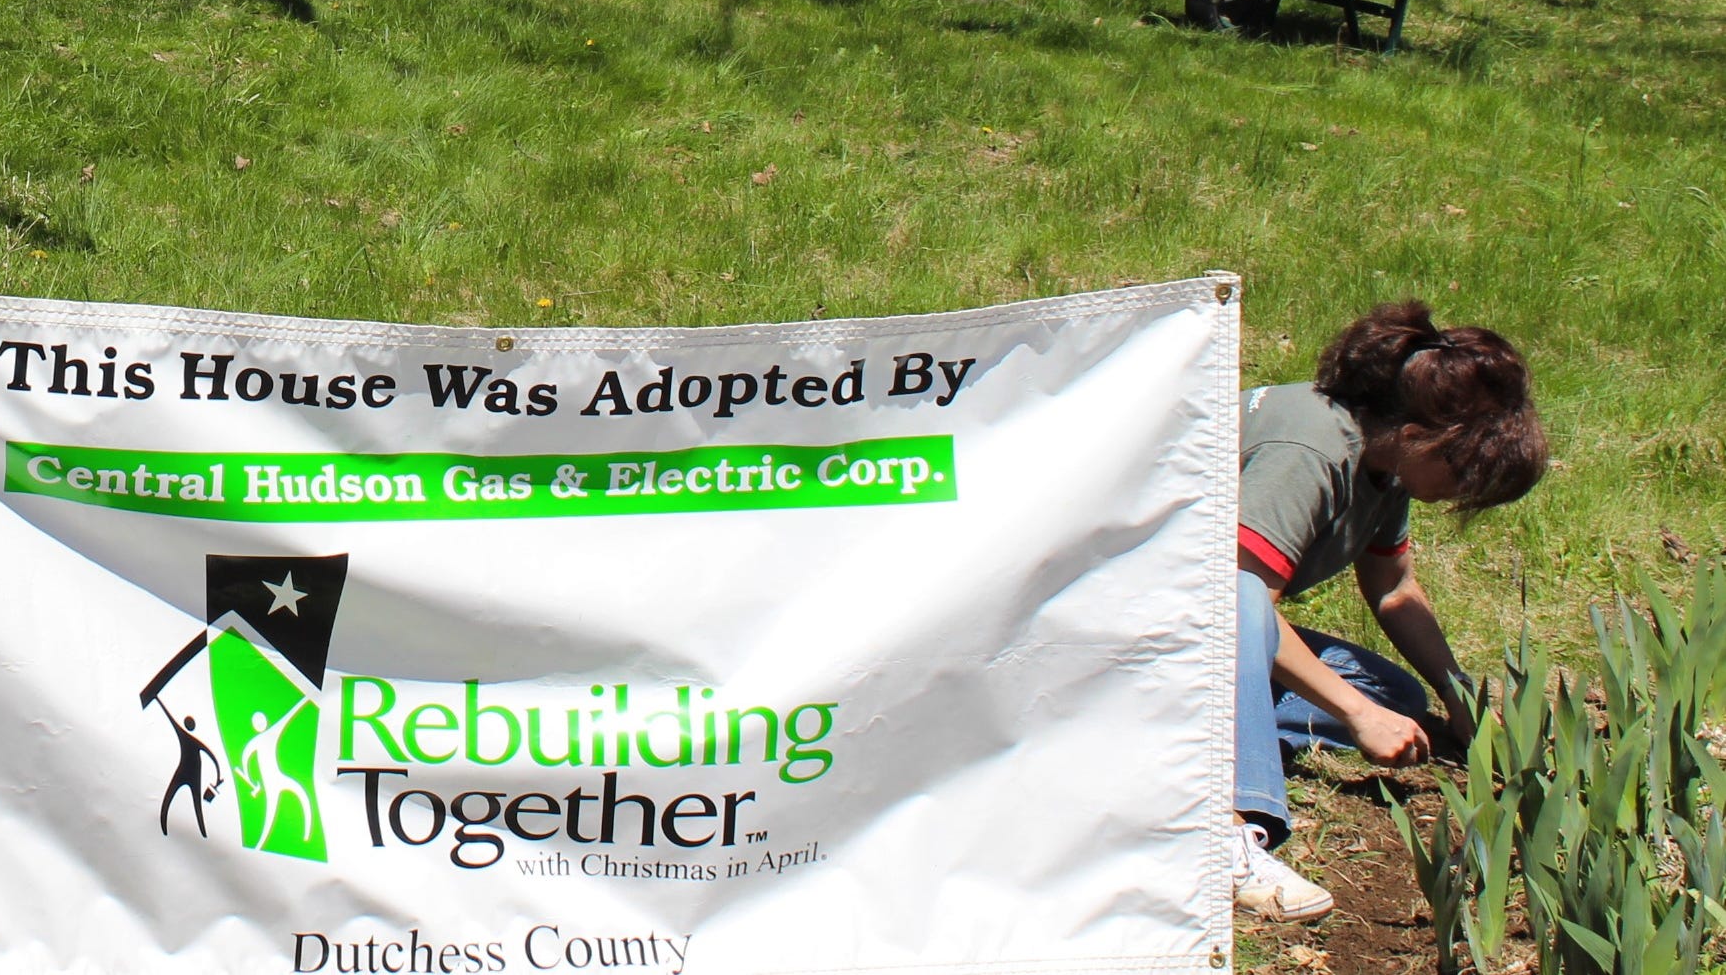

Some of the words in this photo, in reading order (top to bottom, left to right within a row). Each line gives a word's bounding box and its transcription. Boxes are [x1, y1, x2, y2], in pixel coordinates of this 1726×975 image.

[180, 353, 395, 409] House
[422, 364, 558, 416] Was
[579, 359, 864, 419] Adopted
[889, 351, 976, 407] By
[26, 456, 226, 503] Central
[243, 465, 425, 503] Hudson
[442, 465, 532, 500] Gas
[550, 463, 588, 499] &
[606, 454, 802, 499] Electric
[817, 452, 945, 495] Corp.
[337, 675, 839, 785] Rebuilding
[337, 768, 756, 869] Together
[516, 851, 571, 878] with
[580, 851, 717, 882] Christmas
[726, 856, 748, 879] in
[290, 929, 506, 974] Dutchess
[523, 925, 692, 975] County
